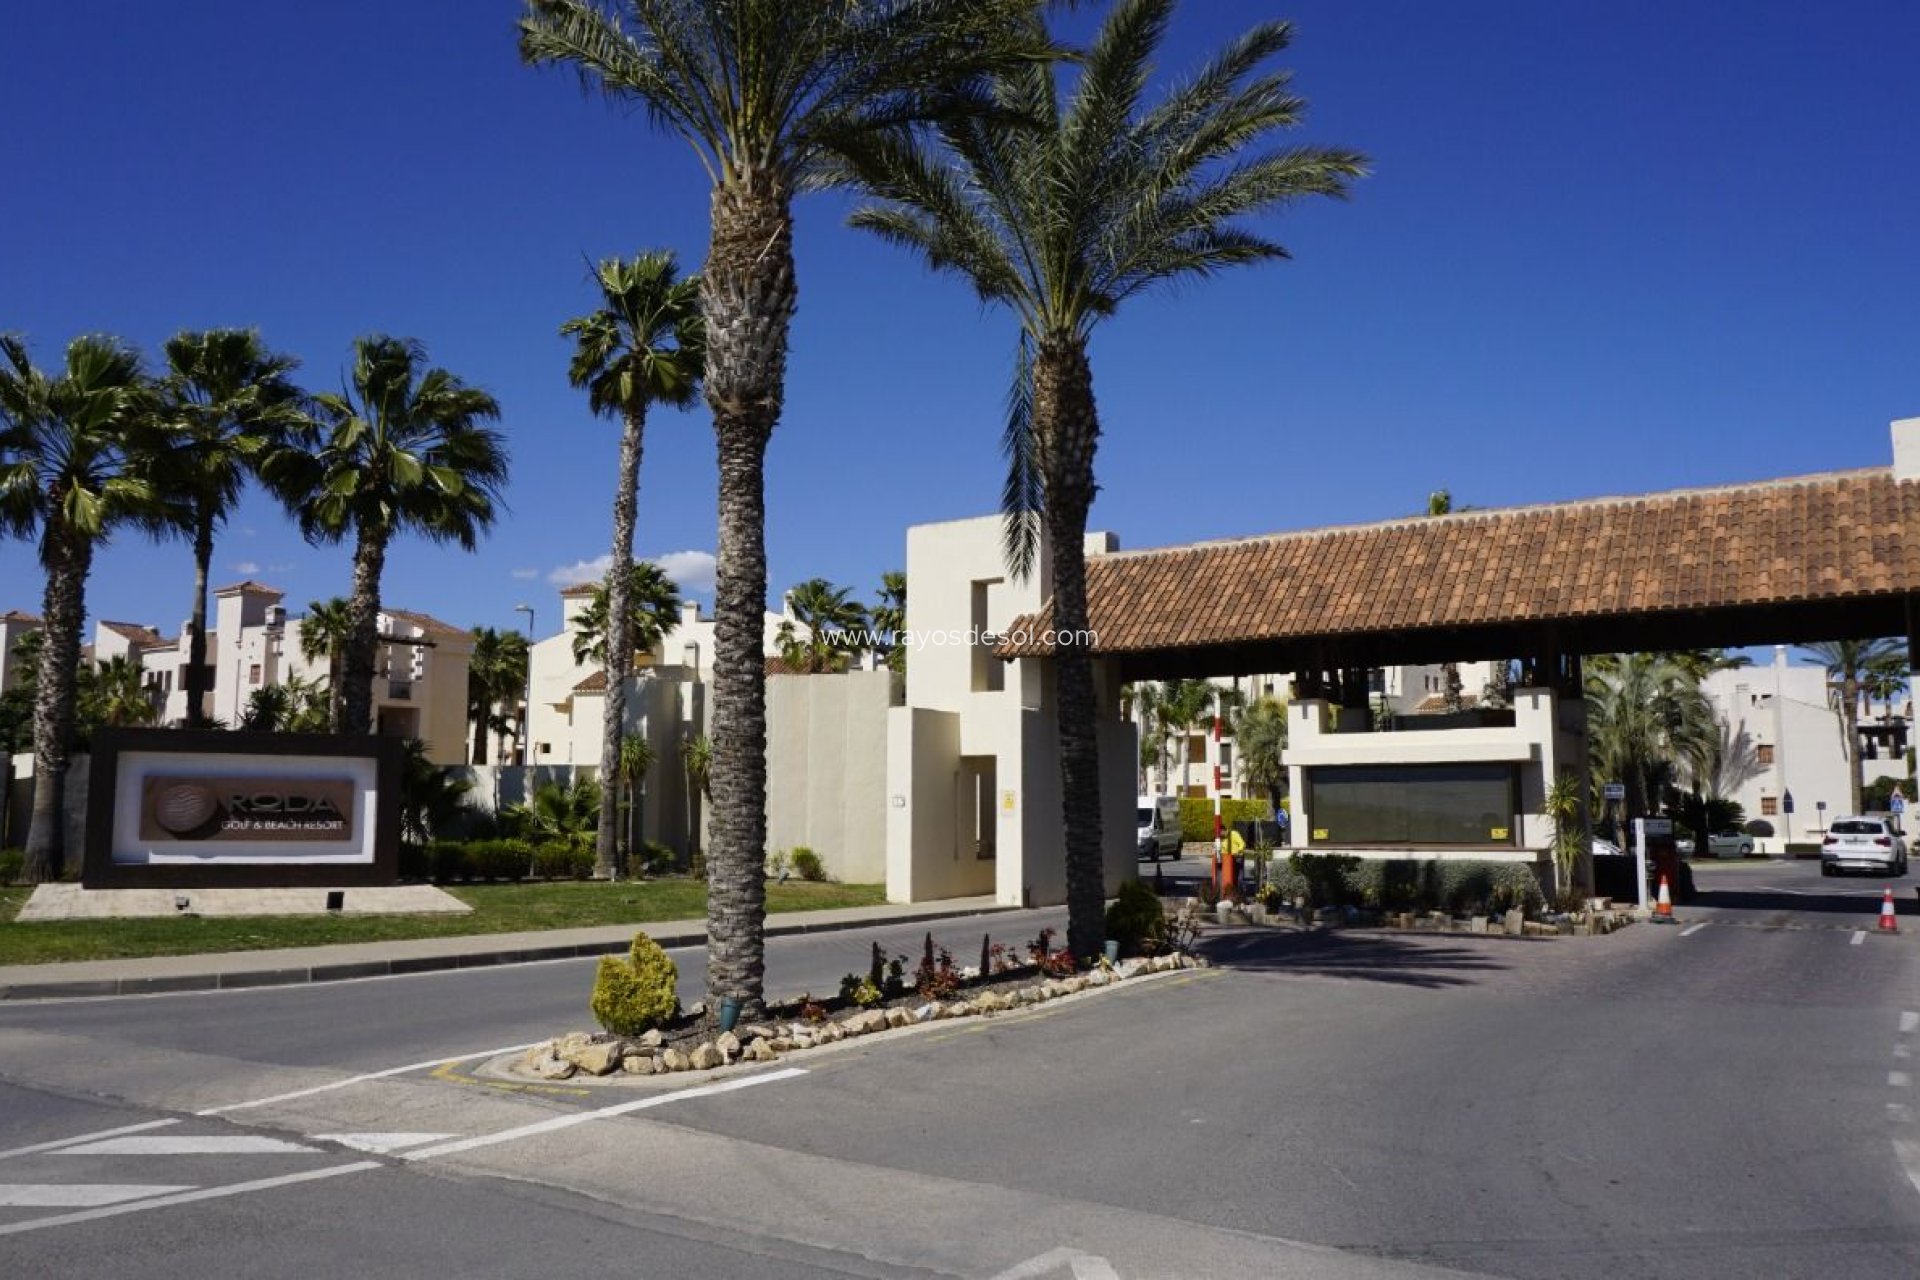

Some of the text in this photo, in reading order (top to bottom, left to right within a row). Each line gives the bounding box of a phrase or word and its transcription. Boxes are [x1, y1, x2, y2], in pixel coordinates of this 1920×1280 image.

[228, 792, 337, 812] RODA
[221, 820, 343, 830] GOLF & BEACH RESORT
